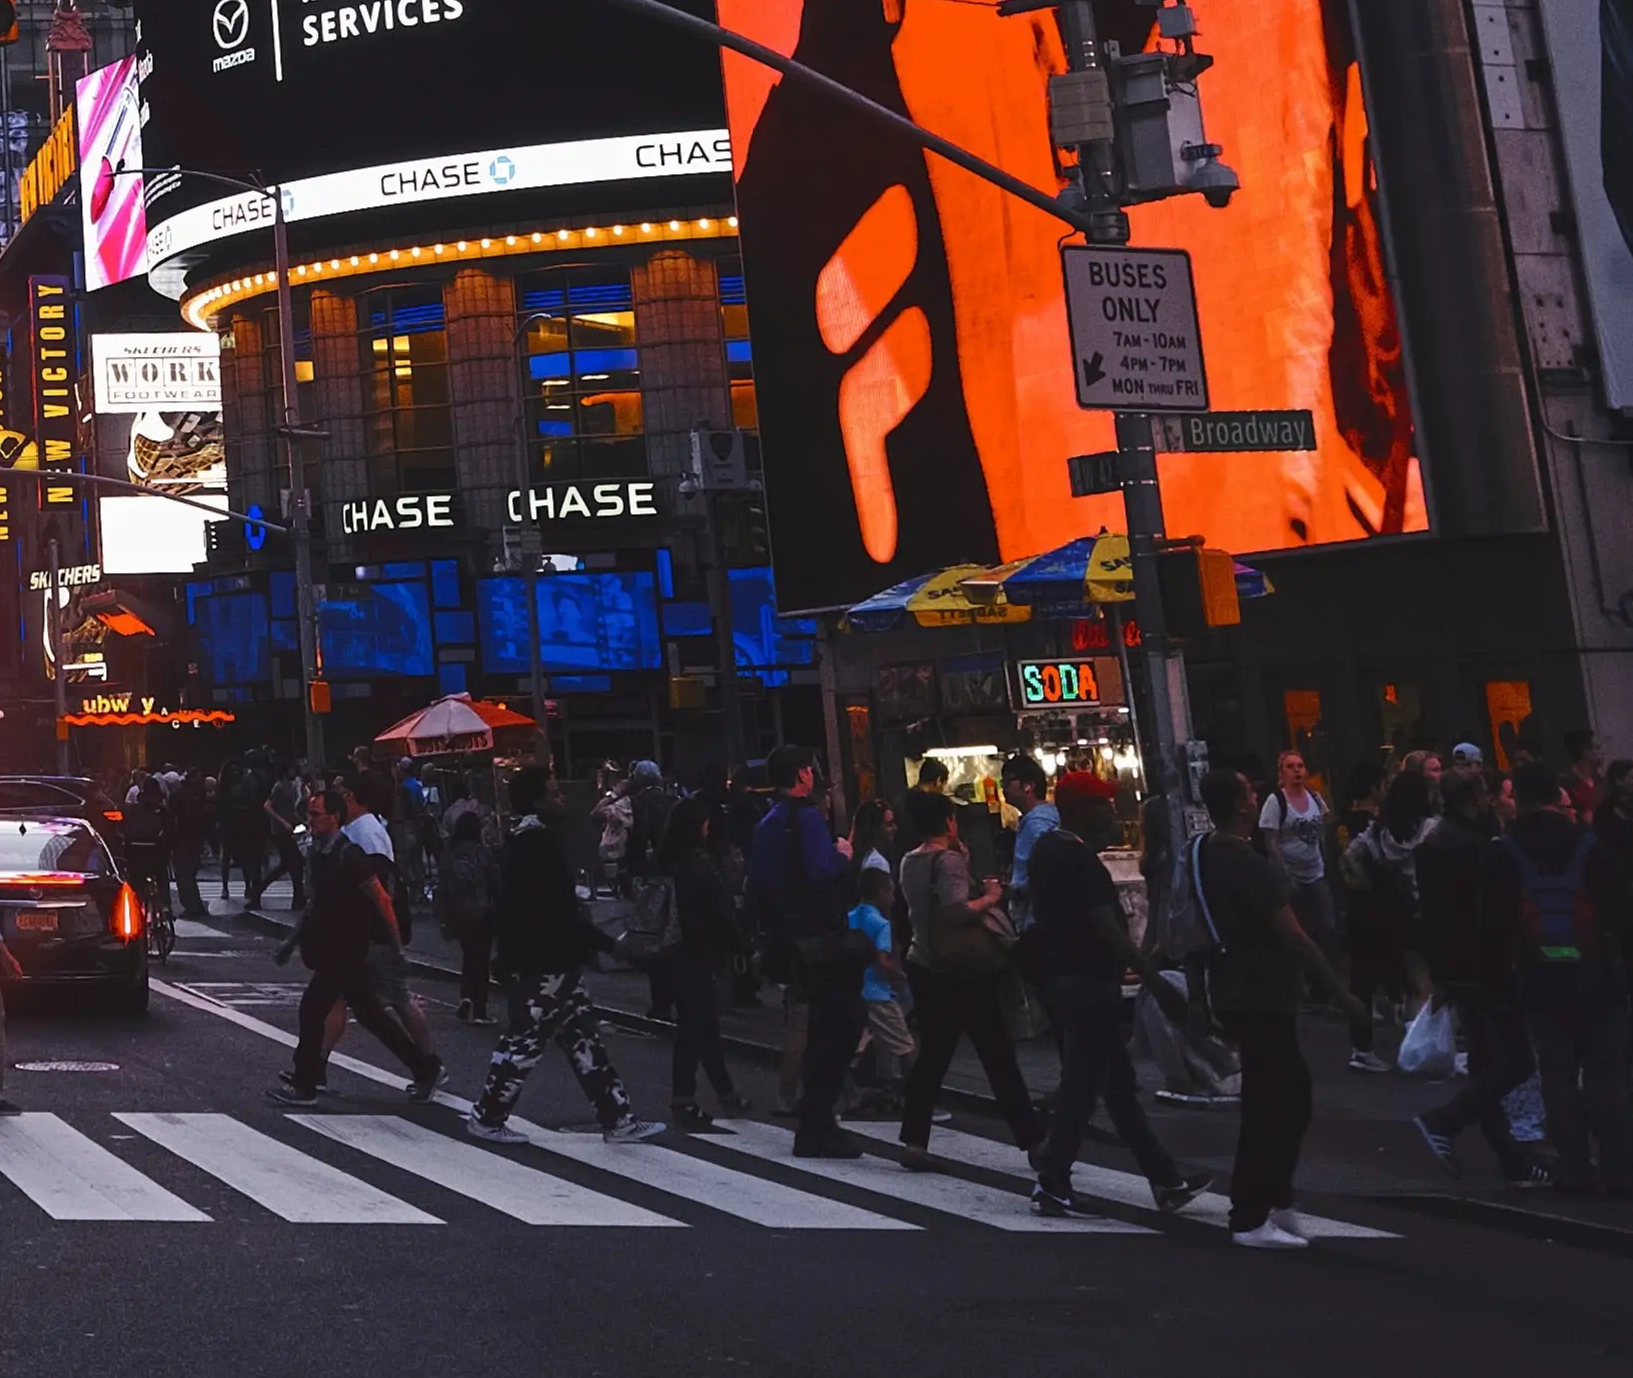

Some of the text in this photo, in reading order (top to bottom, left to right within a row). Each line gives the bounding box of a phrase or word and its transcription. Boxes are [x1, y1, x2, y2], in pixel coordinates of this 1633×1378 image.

[212, 47, 256, 74] mazda
[380, 160, 482, 198] CHASE
[212, 197, 273, 231] CHASE
[1088, 262, 1168, 289] BUSES
[1102, 297, 1161, 324] ONLY
[110, 361, 216, 383] WORK
[1112, 378, 1199, 397] MON THRU FRI
[37, 282, 74, 504] VICTORY NW
[113, 389, 217, 400] FOOTWEAR
[1190, 418, 1306, 450] Broadway
[342, 494, 454, 534] CHASE
[508, 482, 658, 521] CHASE
[1023, 663, 1099, 703] SODA
